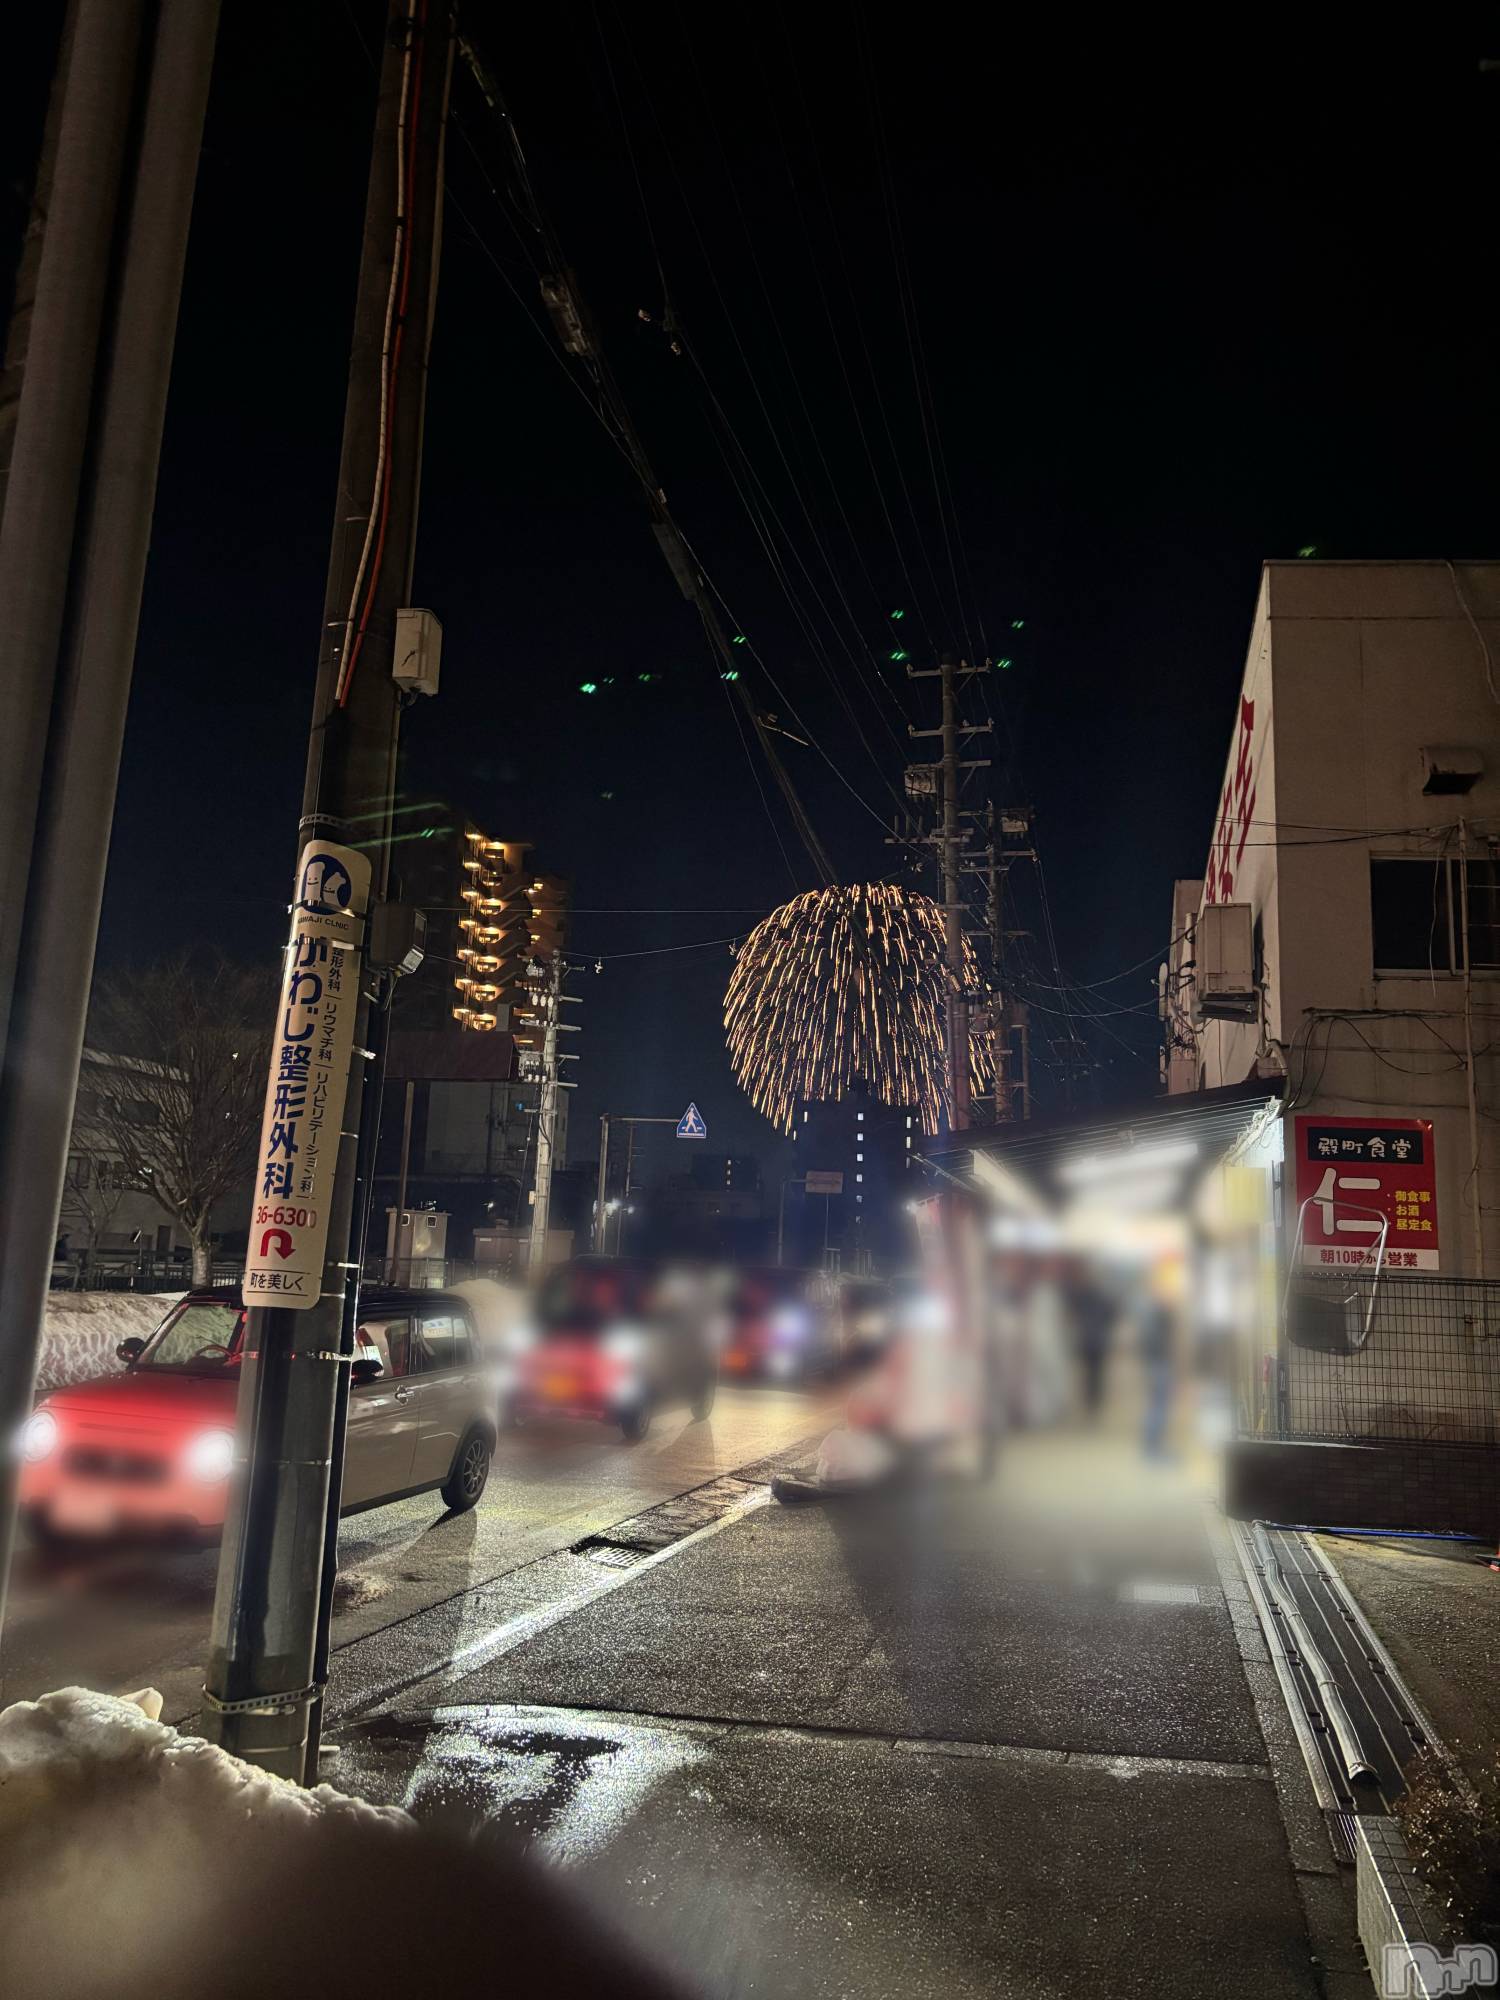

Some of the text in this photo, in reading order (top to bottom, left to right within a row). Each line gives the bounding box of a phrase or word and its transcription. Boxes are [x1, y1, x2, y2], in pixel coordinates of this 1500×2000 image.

[318, 1002, 337, 1062] リウマチ科
[1318, 1137, 1412, 1159] 殿町食堂
[1312, 1167, 1384, 1236] 仁
